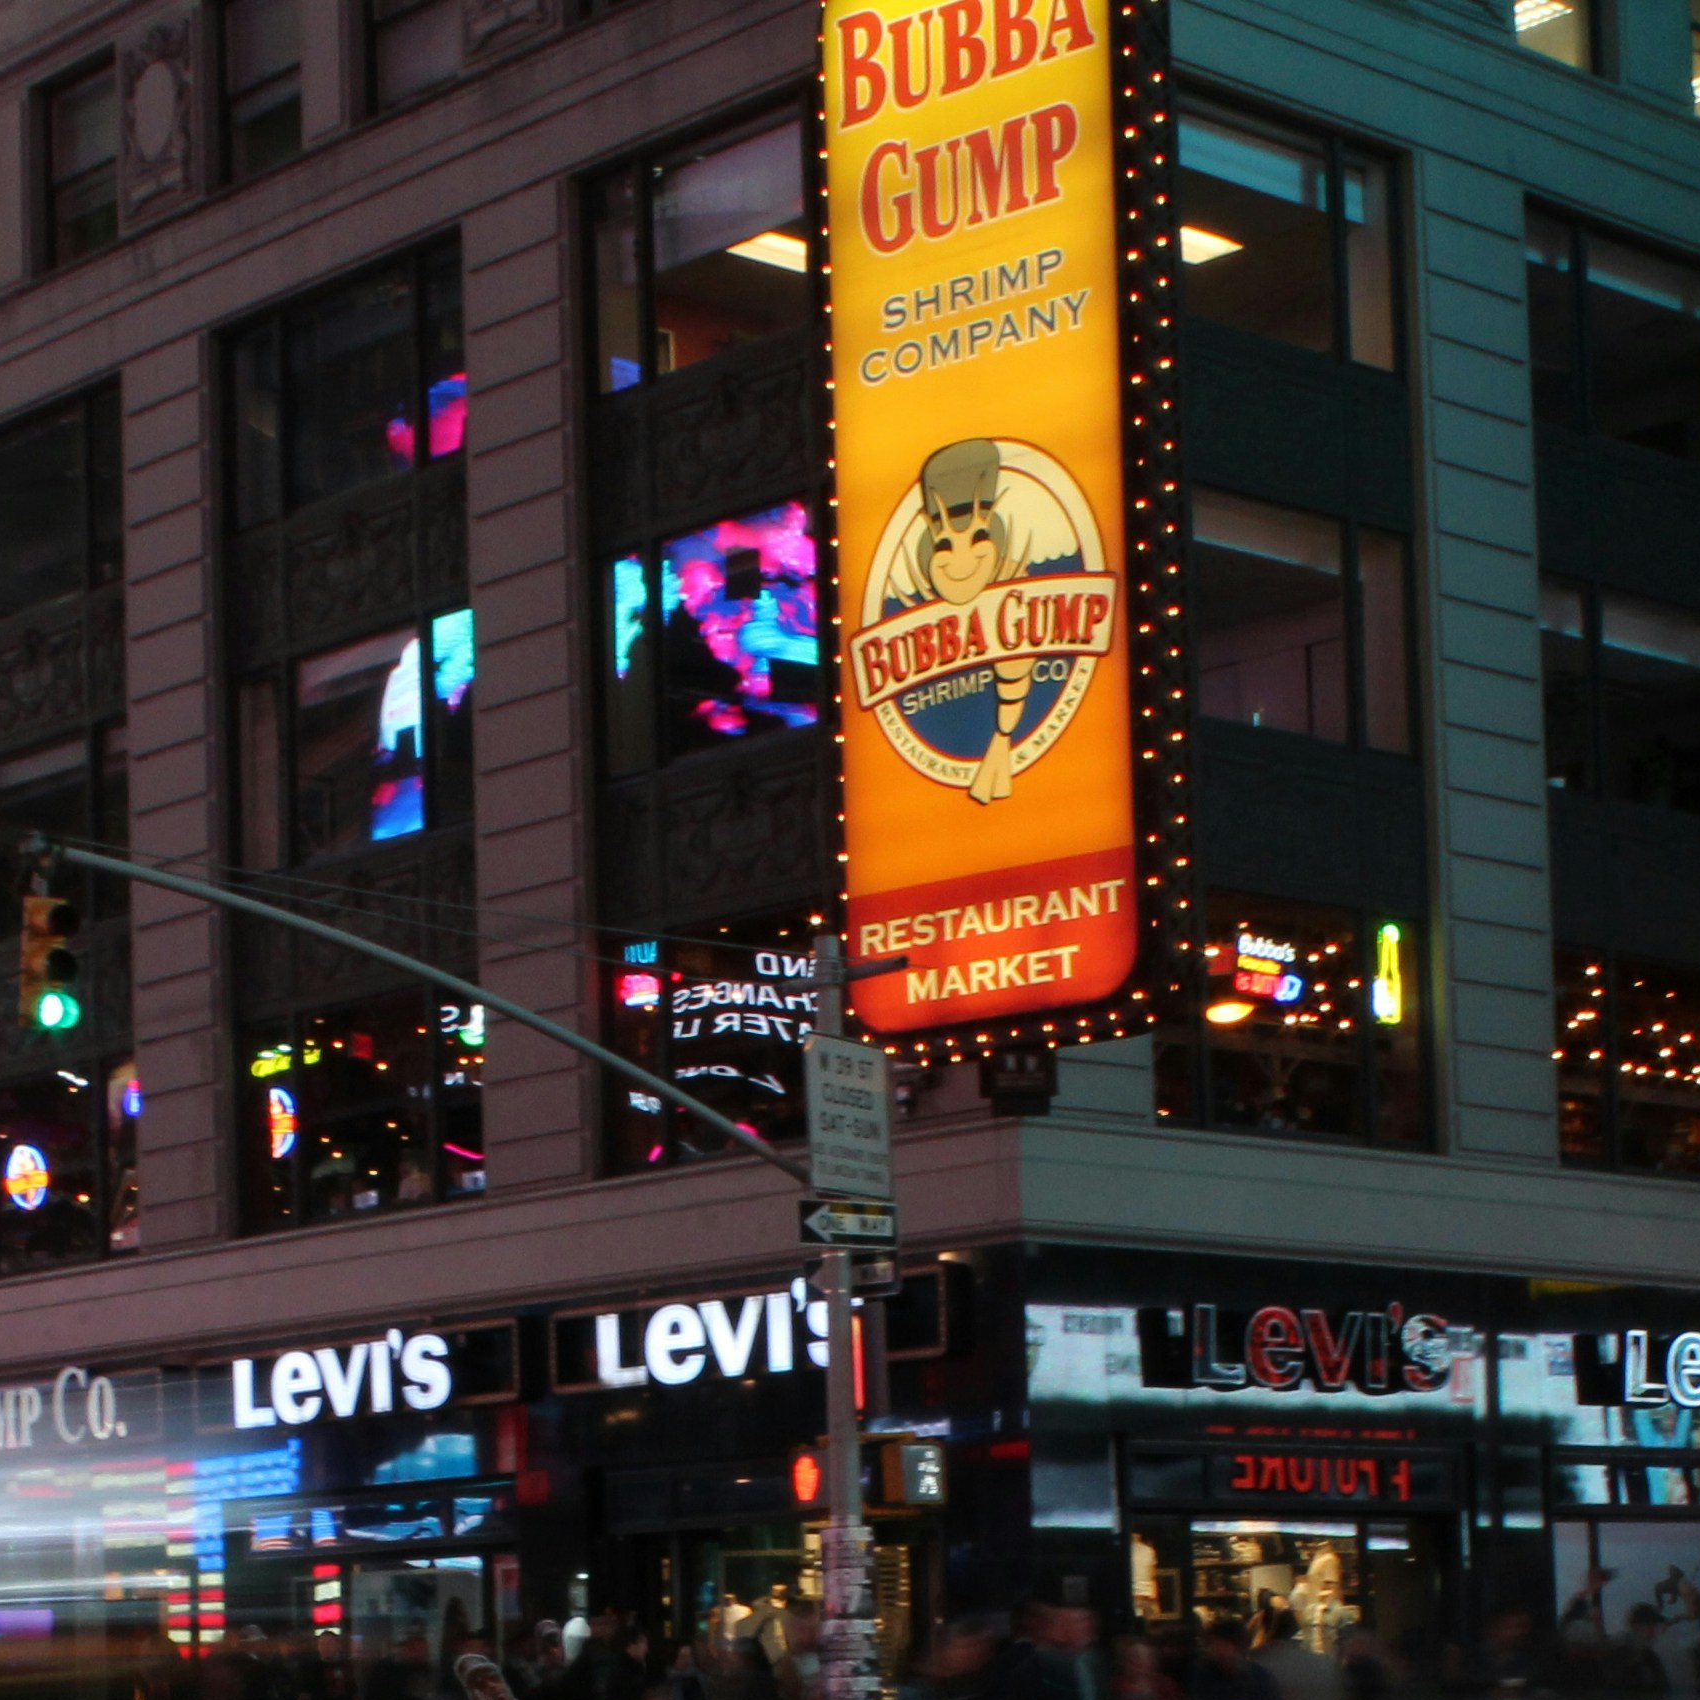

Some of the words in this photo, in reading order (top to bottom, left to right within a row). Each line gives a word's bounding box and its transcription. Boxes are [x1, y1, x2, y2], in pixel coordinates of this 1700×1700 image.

[837, 0, 1098, 130] BUBBA
[858, 102, 1079, 258] GUMP
[882, 247, 1066, 332] SHRIMP
[860, 289, 1091, 387] COMPANY
[861, 607, 989, 695] BUBBA
[997, 589, 1110, 652] GUMP
[879, 703, 973, 780] RESTAURANT
[1031, 666, 1089, 748] MARKET
[902, 669, 995, 716] SHRIMP
[858, 879, 1127, 957] RESTAURANT
[906, 945, 1082, 1005] MARKET
[821, 1082, 875, 1111] CLOSED
[857, 1059, 874, 1079] ST
[819, 1111, 882, 1140] SAT-SUN
